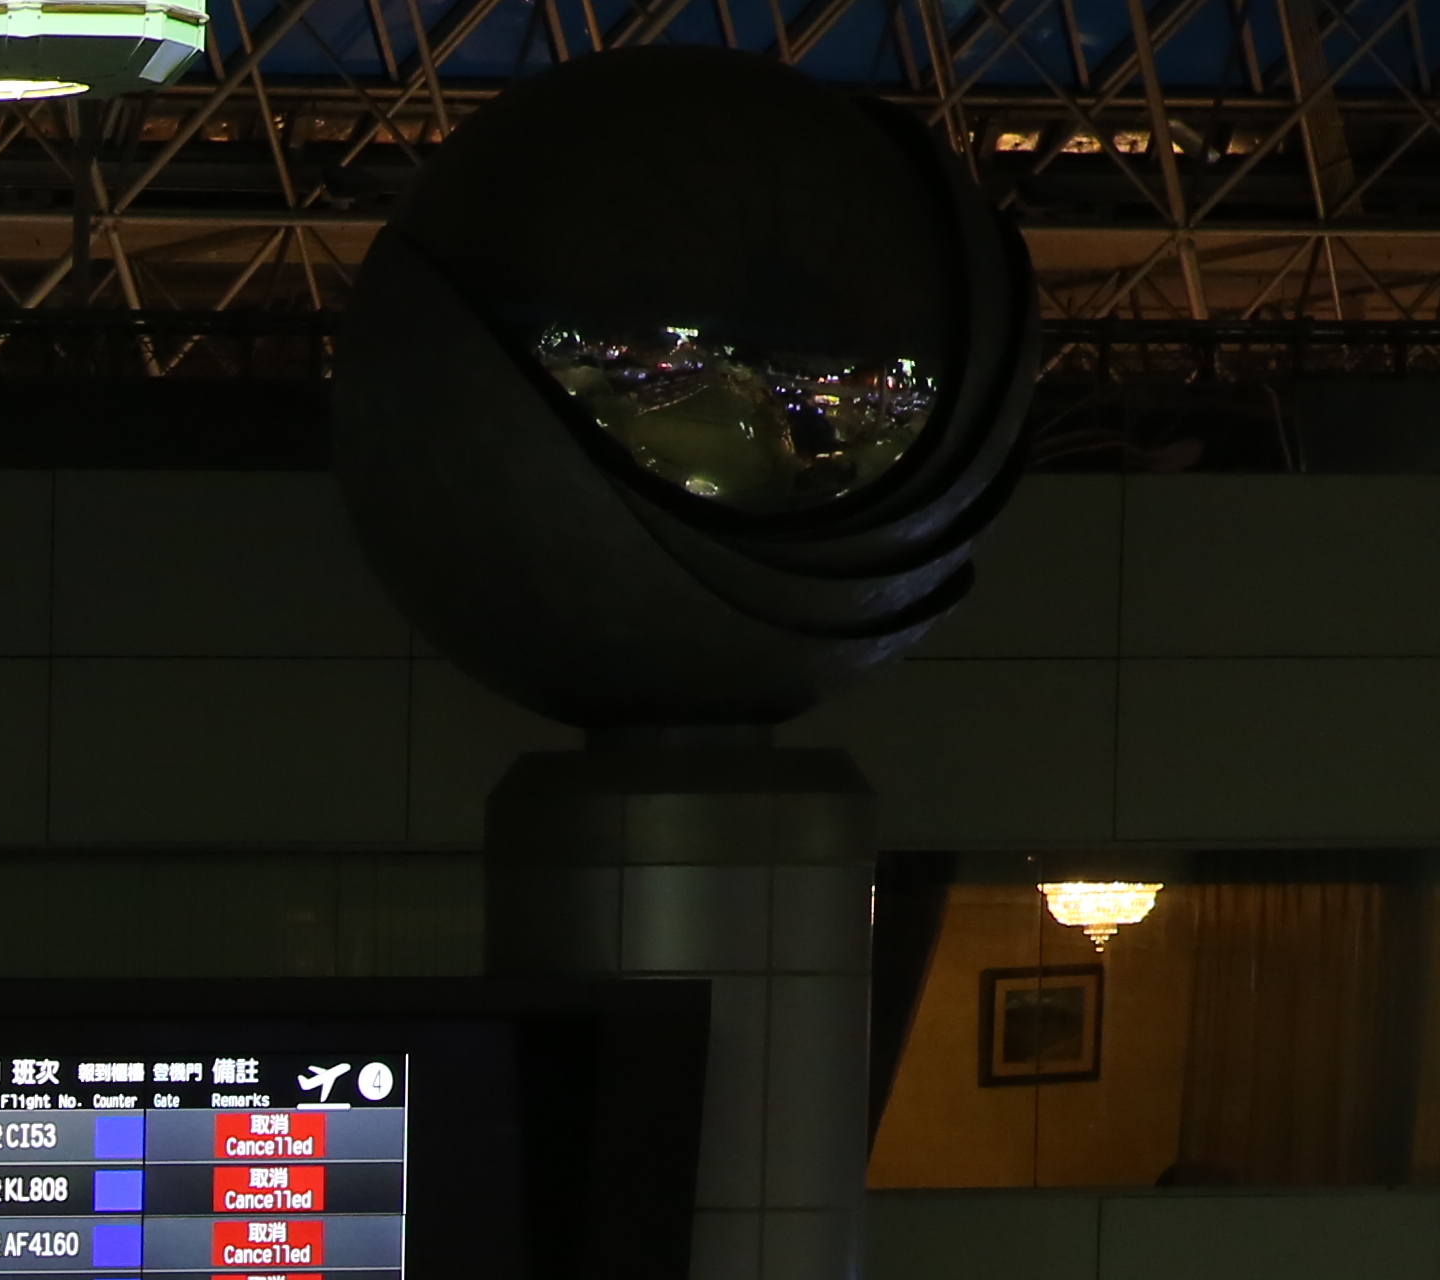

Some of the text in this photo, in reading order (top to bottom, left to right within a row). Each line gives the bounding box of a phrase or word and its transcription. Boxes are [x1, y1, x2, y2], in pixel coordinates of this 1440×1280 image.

[249, 1167, 288, 1188] 取消
[5, 1177, 67, 1201] KL808
[226, 1190, 311, 1209] Cancelled
